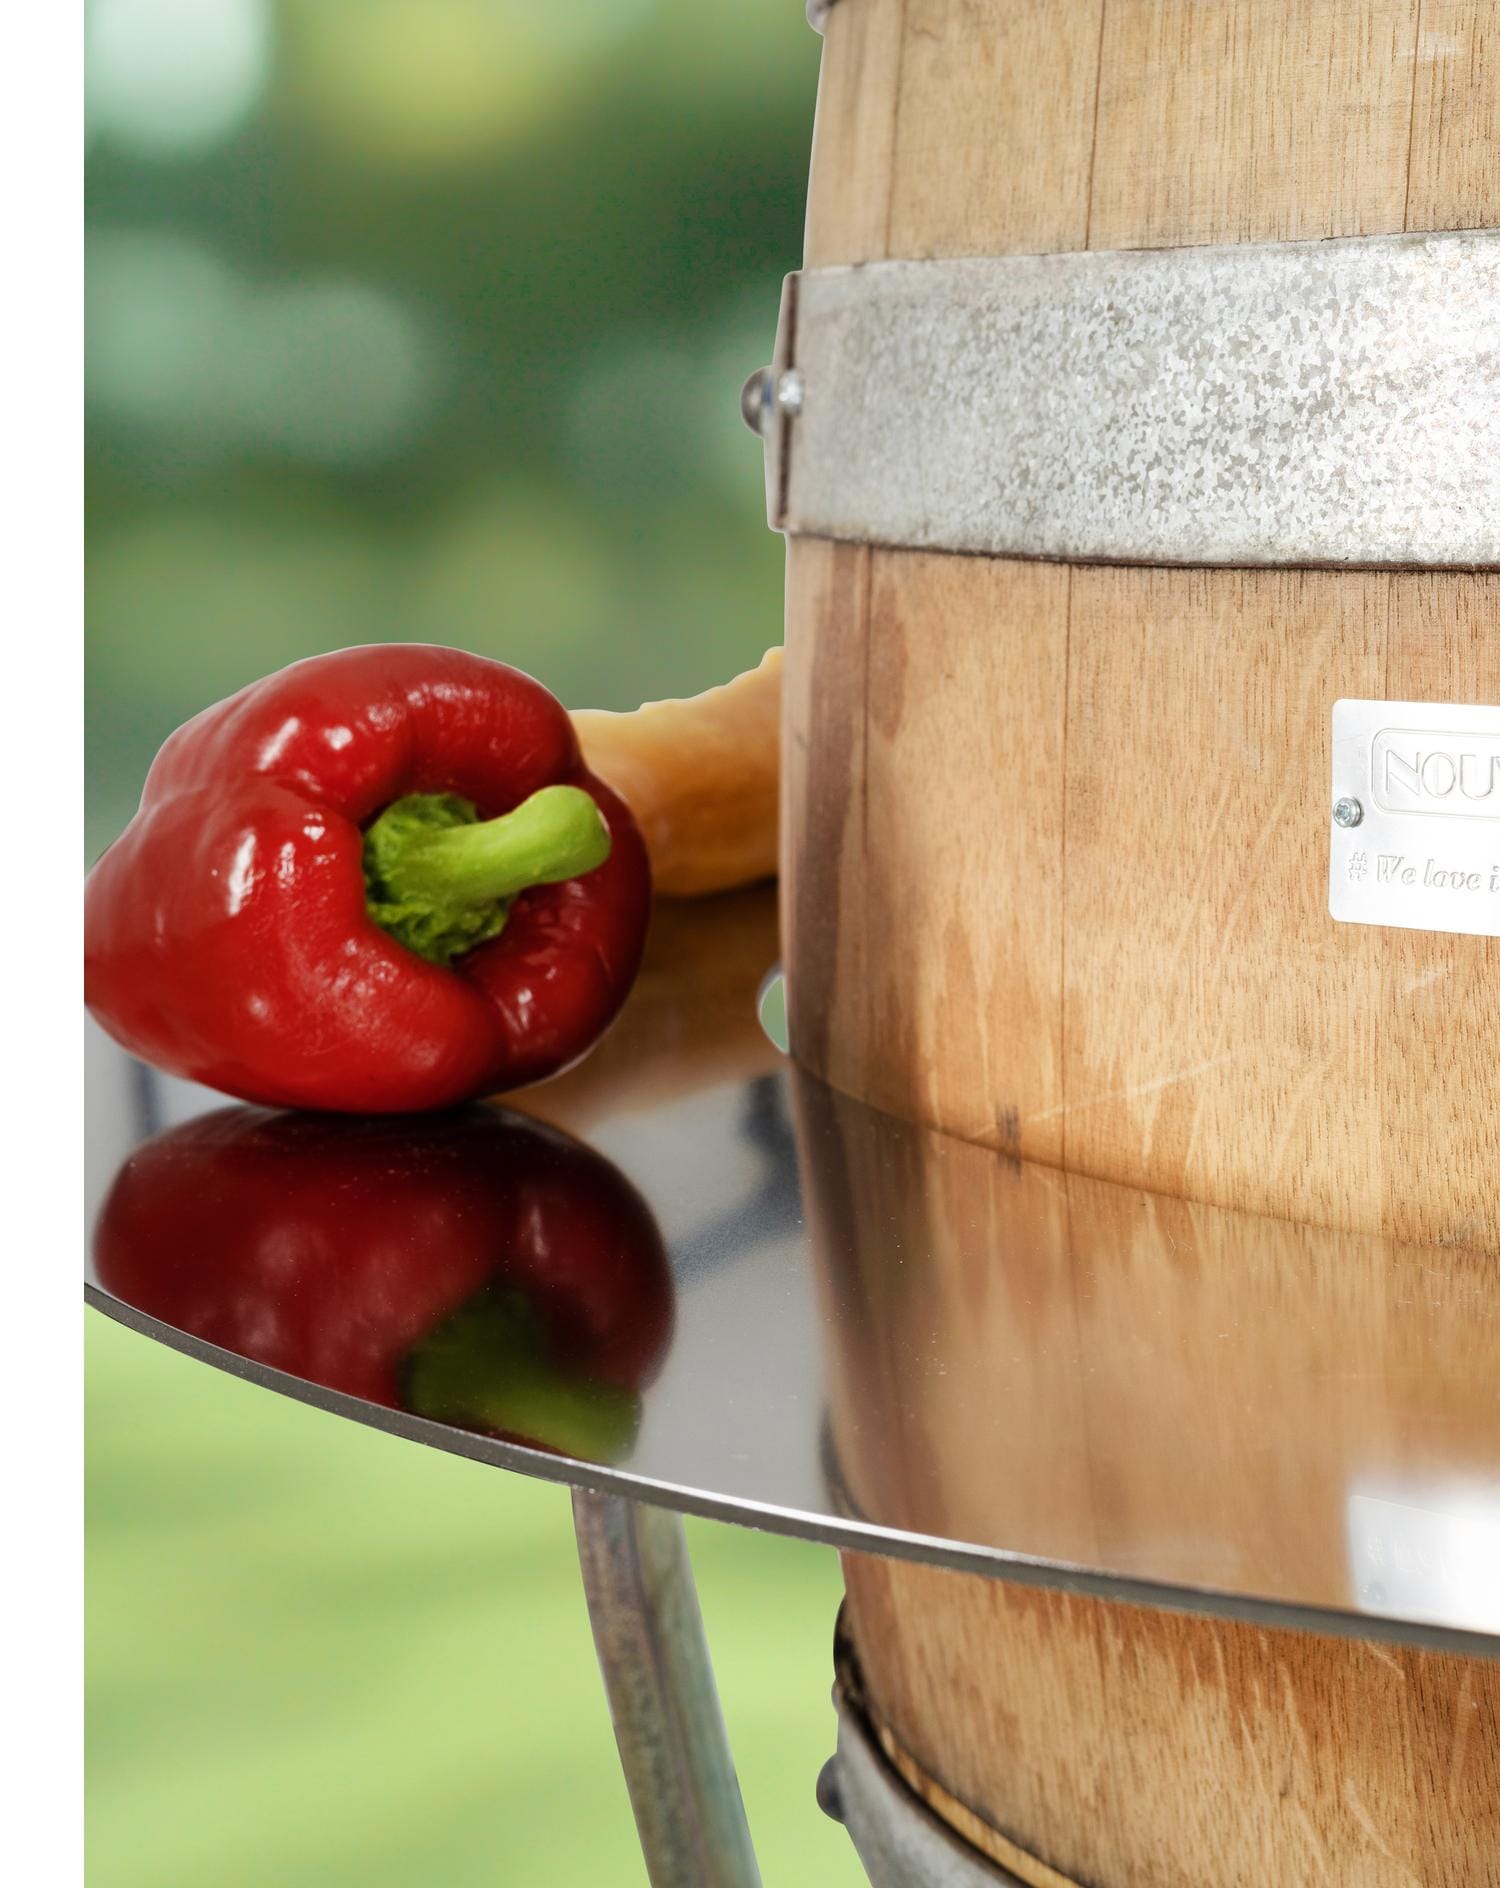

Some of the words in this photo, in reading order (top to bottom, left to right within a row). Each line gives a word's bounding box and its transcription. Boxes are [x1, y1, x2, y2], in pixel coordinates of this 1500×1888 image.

[1348, 851, 1368, 882] #
[1376, 854, 1416, 886] We
[1423, 857, 1481, 891] love
